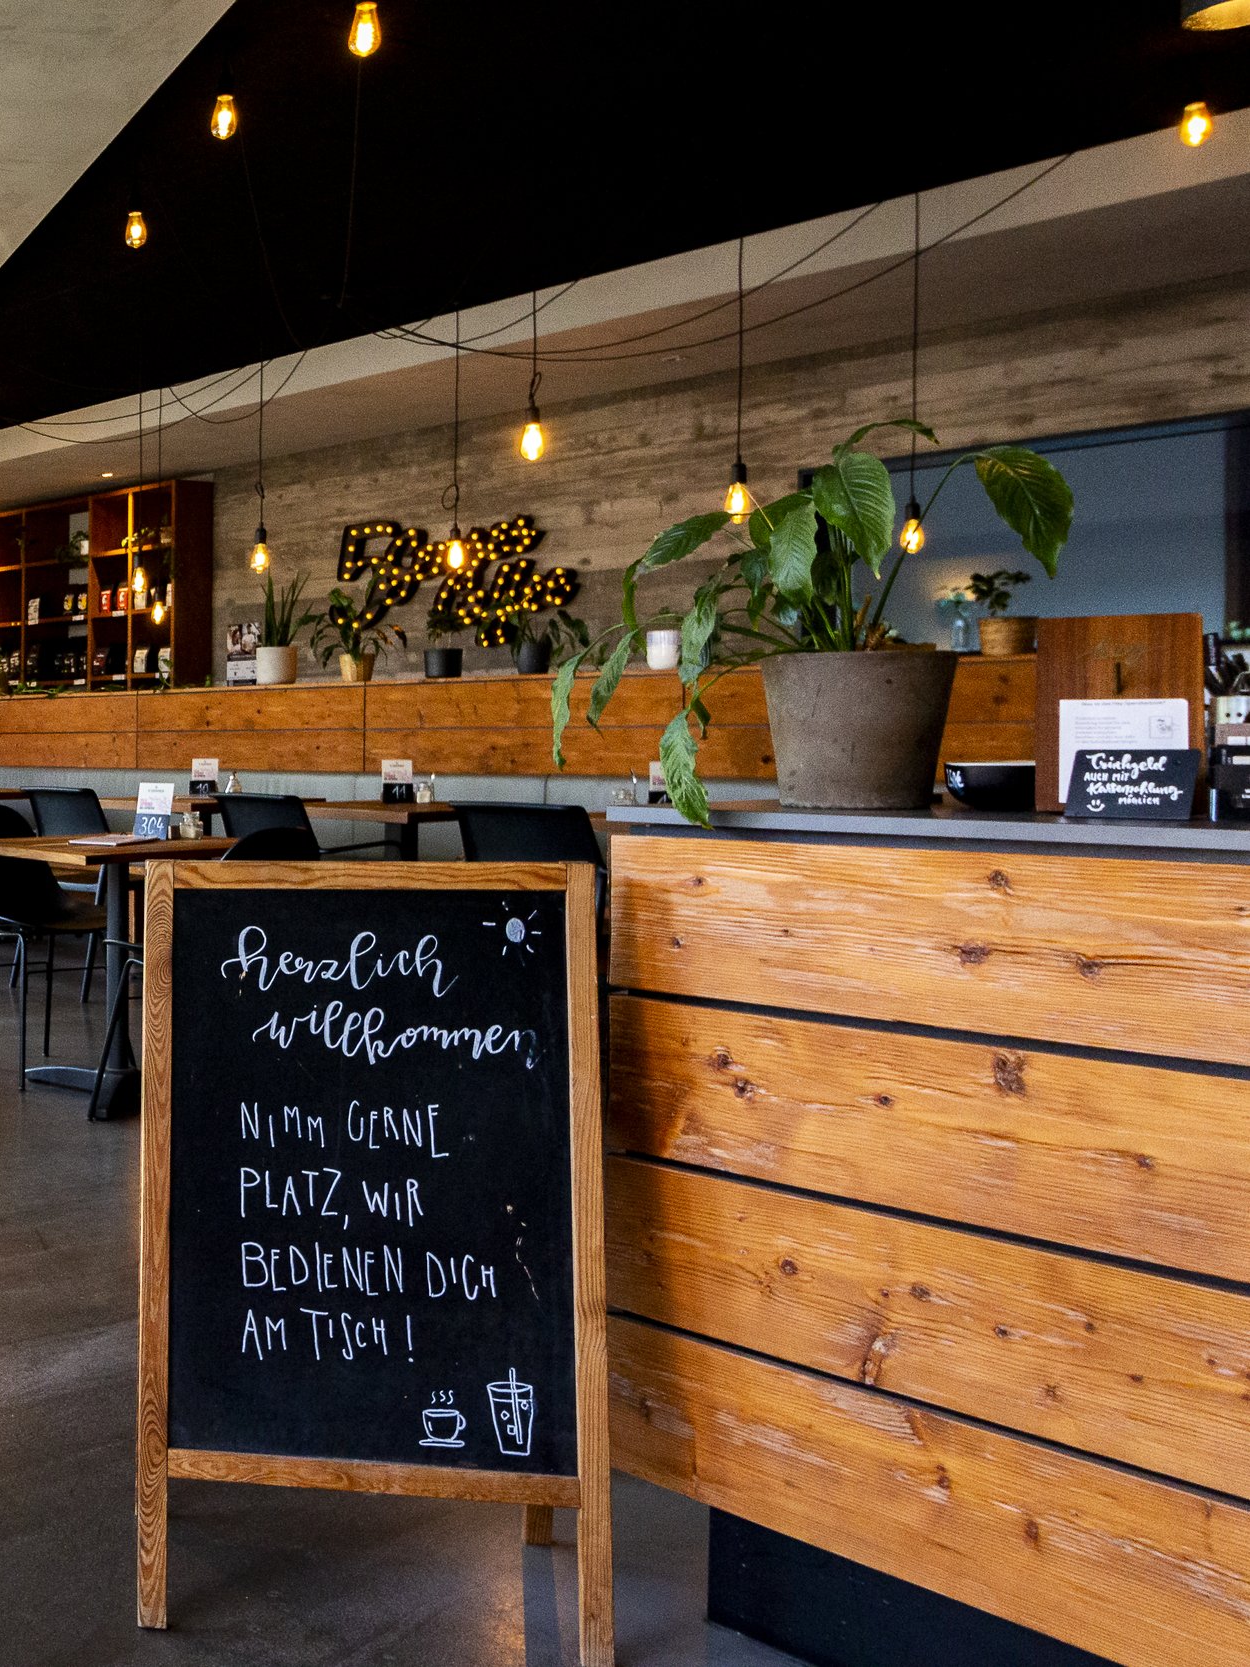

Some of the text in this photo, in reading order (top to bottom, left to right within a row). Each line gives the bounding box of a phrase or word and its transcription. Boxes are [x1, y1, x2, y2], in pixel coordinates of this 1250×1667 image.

[1083, 771, 1109, 782] AUCH
[1085, 752, 1168, 779] Trinkgeld
[221, 925, 460, 998] herzlich
[252, 1000, 546, 1069] willkommen
[240, 1100, 450, 1158] NIMM GERNE
[240, 1167, 425, 1230] PLATZ, WIR
[241, 1241, 497, 1301] BEDIENEN DICH
[241, 1309, 288, 1361] AM
